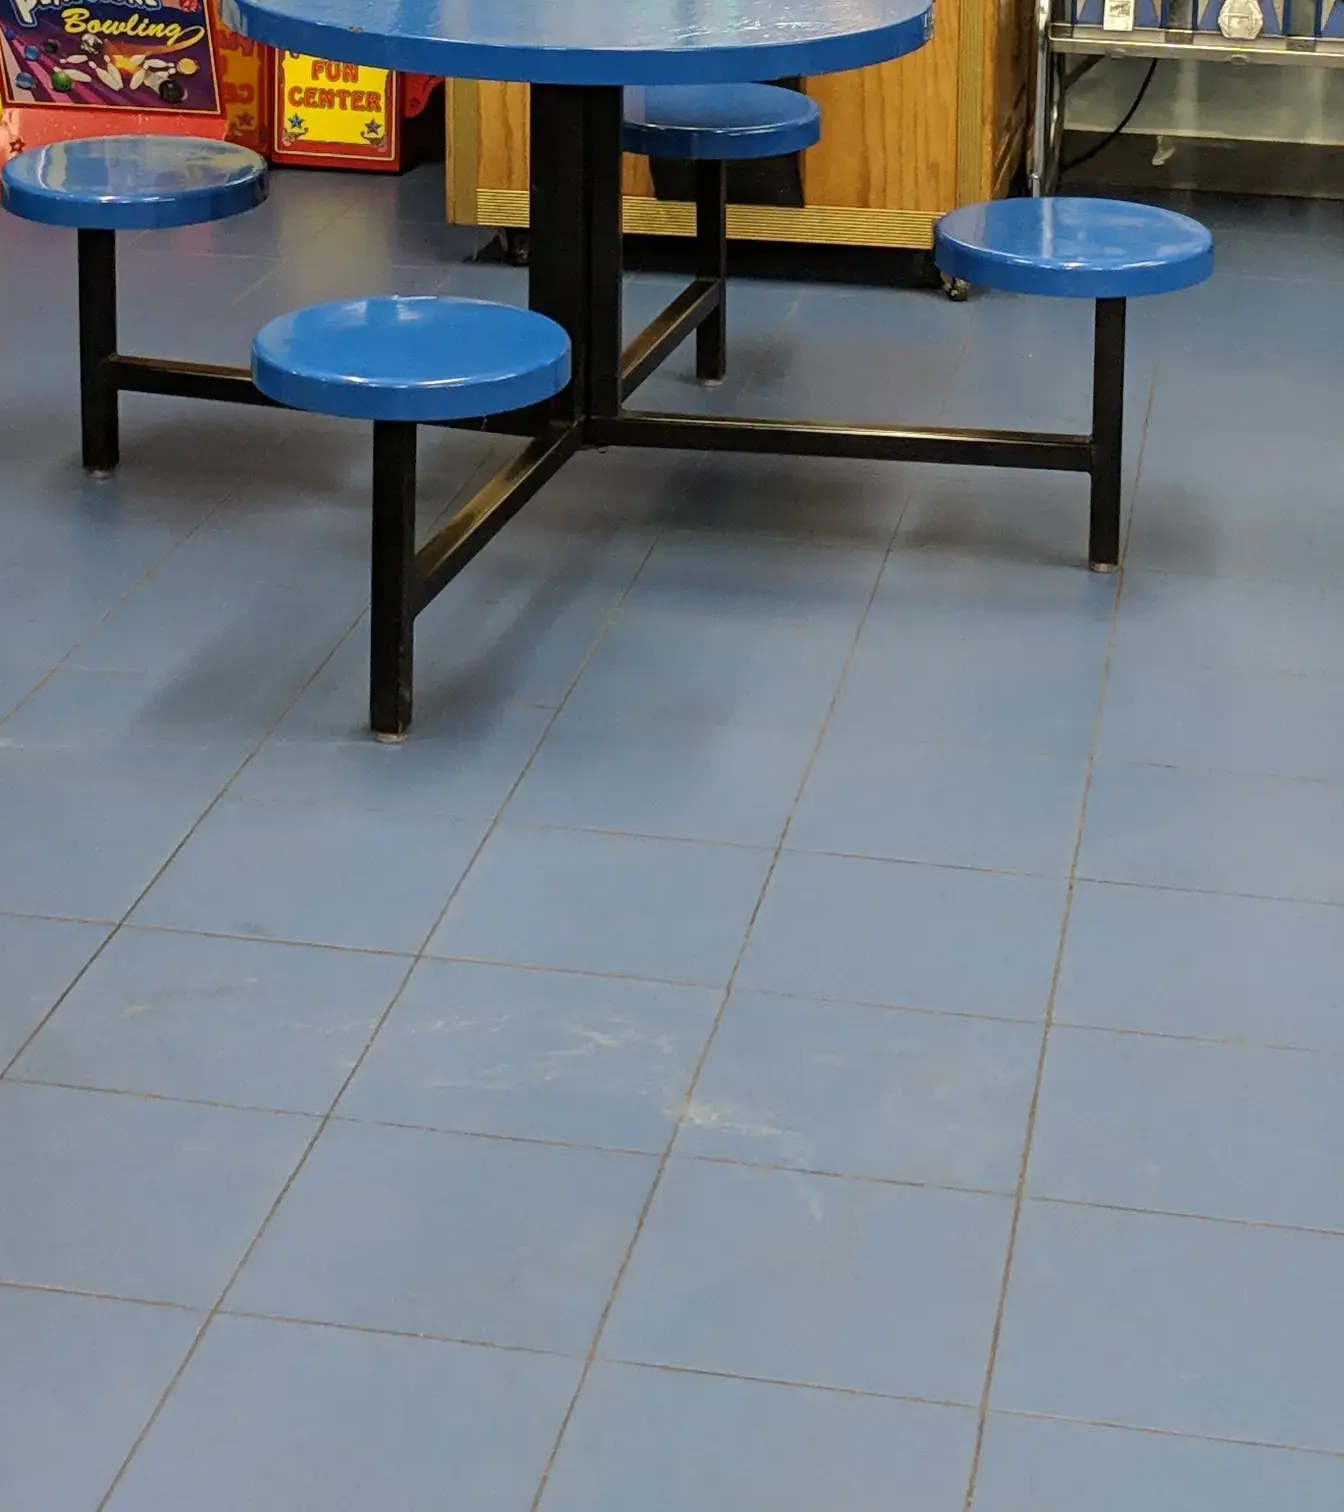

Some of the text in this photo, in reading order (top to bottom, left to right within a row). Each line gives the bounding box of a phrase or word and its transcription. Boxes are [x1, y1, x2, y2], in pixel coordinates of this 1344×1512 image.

[61, 7, 205, 47] Bowling
[311, 59, 359, 82] FUN
[287, 85, 382, 113] CENTER
